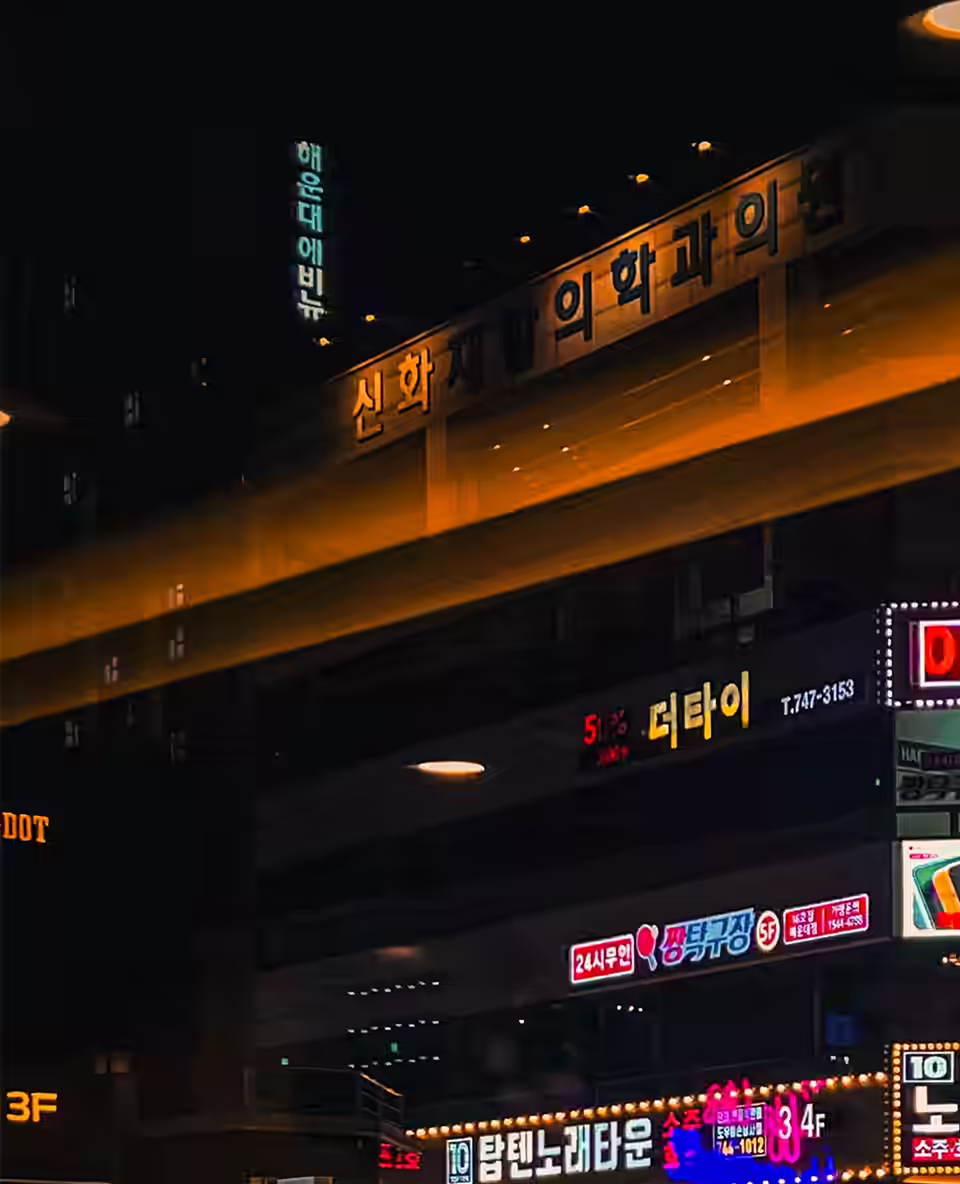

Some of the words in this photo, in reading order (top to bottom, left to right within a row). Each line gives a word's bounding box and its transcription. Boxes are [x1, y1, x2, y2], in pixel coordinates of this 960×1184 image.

[647, 669, 750, 749] 더타이
[780, 678, 856, 715] T.747-3153
[661, 907, 755, 966] 짱탁구장
[575, 942, 632, 976] 24시무인
[911, 1056, 948, 1080] 10
[6, 1090, 58, 1123] 3F
[449, 1140, 470, 1176] 10
[478, 1117, 653, 1184] 탑텐노래타운
